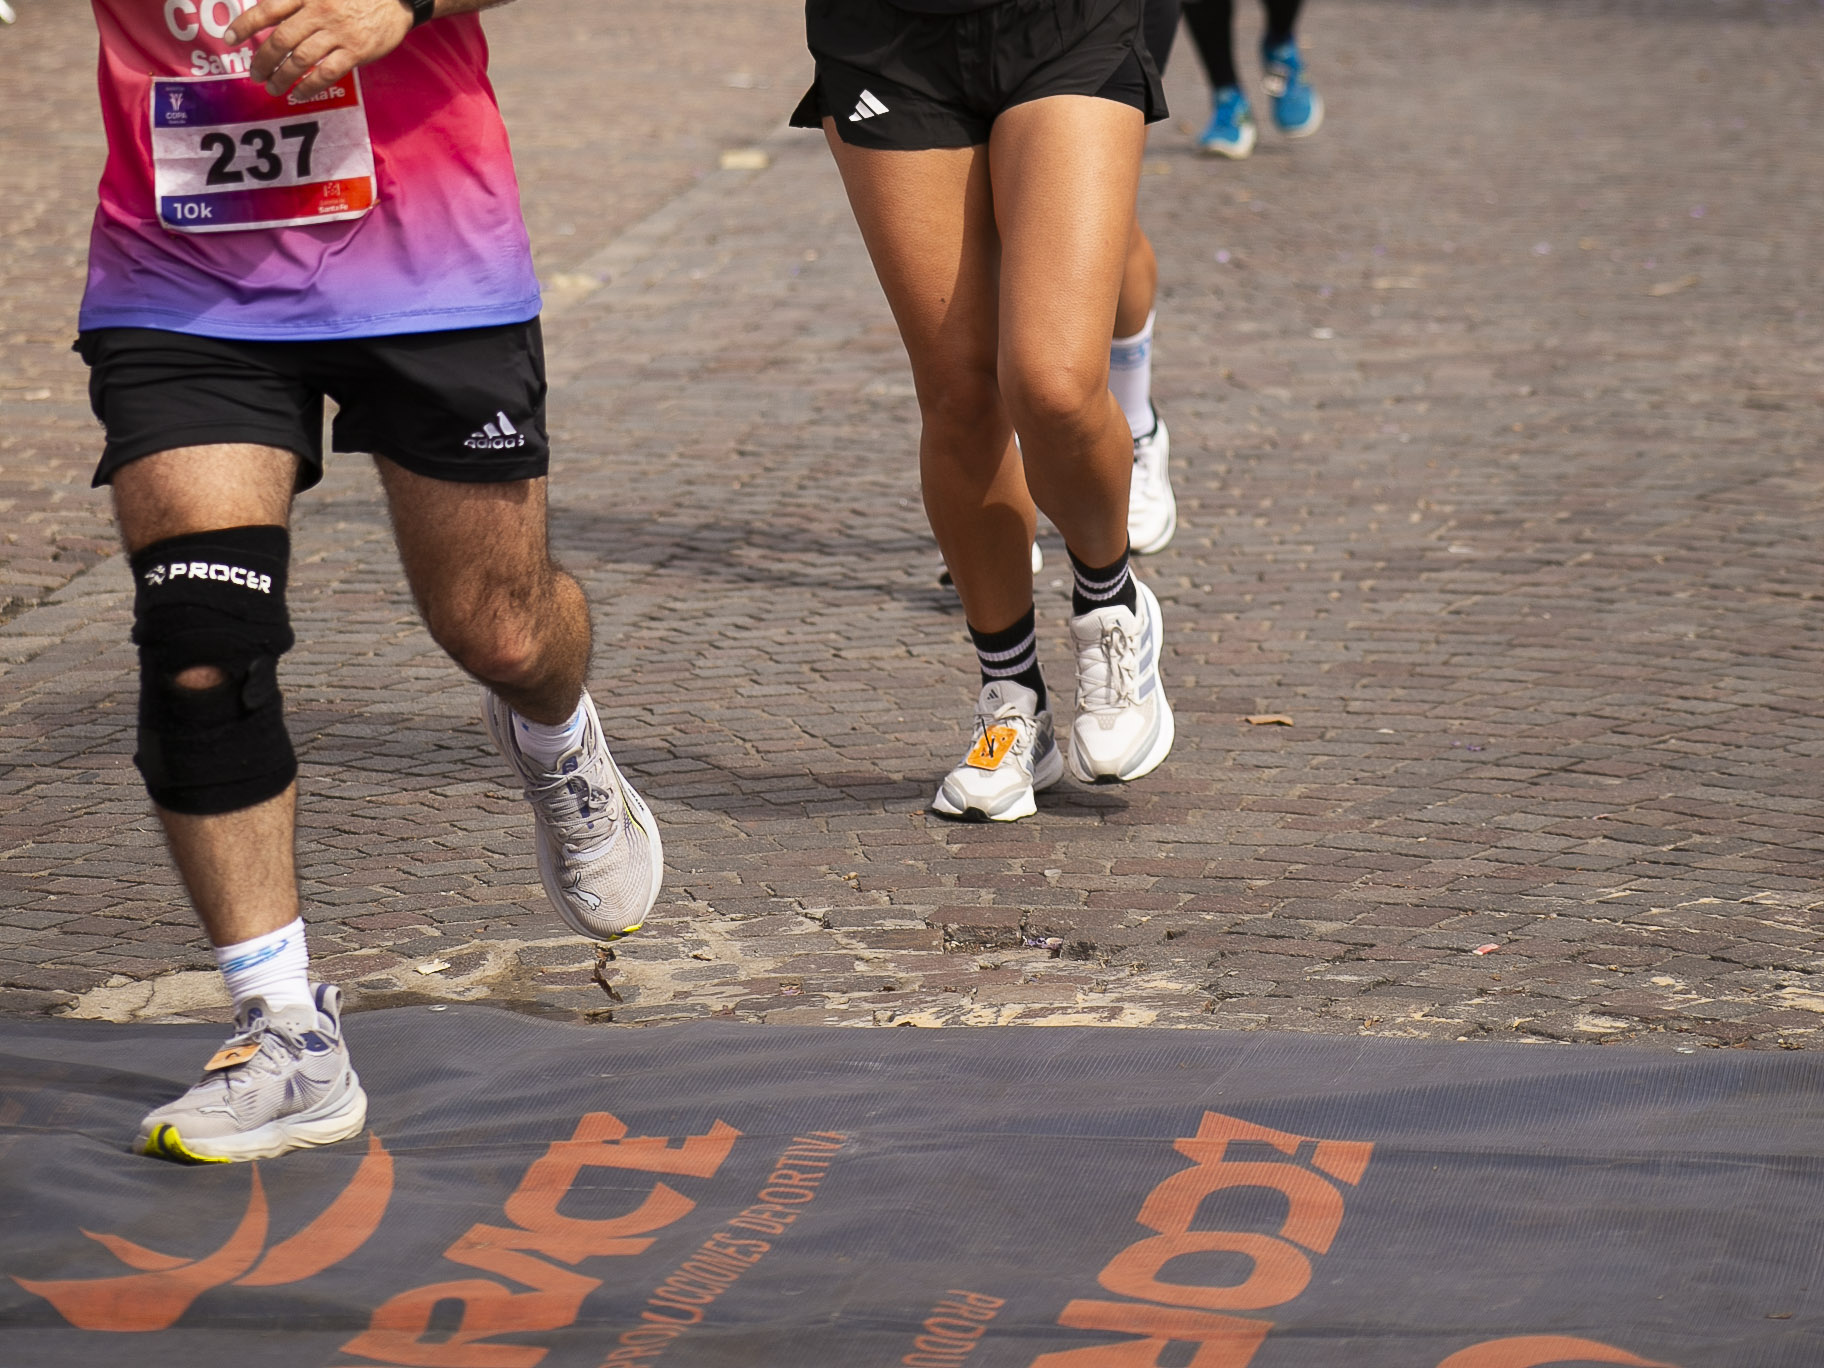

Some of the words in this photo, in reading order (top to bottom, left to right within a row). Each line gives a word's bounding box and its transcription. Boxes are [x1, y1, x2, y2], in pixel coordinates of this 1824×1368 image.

[328, 86, 346, 100] Fe
[200, 121, 320, 186] 237
[173, 202, 213, 219] 10k
[169, 561, 272, 594] PROCER
